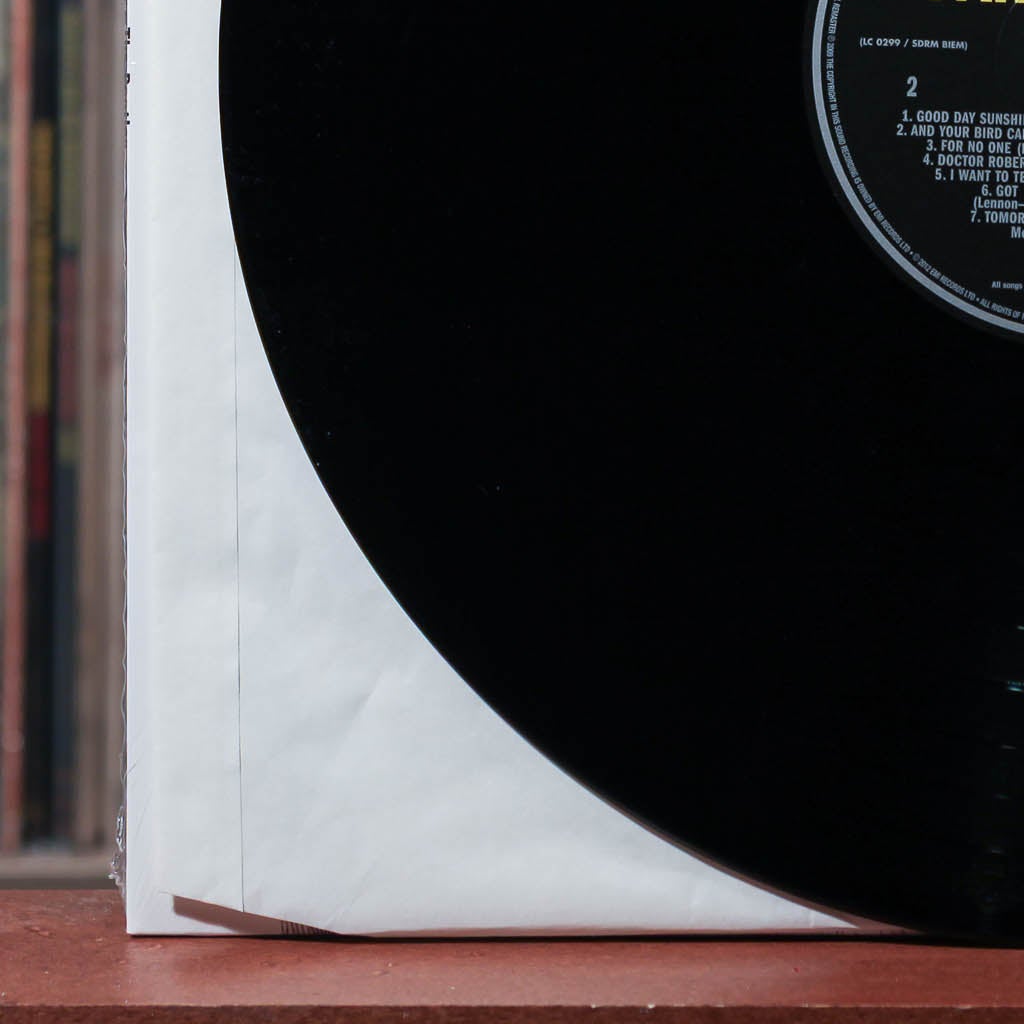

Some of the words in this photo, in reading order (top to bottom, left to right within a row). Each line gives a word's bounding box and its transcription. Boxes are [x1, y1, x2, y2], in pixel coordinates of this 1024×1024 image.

[859, 37, 873, 48] (LC
[876, 38, 901, 47] 0299
[912, 39, 939, 49] SDRM
[942, 40, 968, 51] BIEM)
[906, 75, 918, 97] 2
[902, 109, 913, 122] 1.
[916, 110, 950, 123] GOOD
[953, 111, 976, 124] DAY
[896, 124, 908, 136] 2.
[910, 124, 935, 137] AND
[940, 125, 970, 138] YOUR
[974, 126, 1003, 139] BIRD
[926, 139, 937, 152] 3.
[941, 139, 963, 153] FOR
[967, 140, 984, 153] NO
[988, 141, 1012, 154] ONE
[922, 153, 934, 166] 4.
[937, 154, 984, 167] DOCTOR
[935, 168, 946, 181] 5.
[950, 169, 954, 181] I
[958, 169, 991, 182] WANT
[994, 170, 1009, 183] TO
[981, 183, 992, 197] 6.
[996, 184, 1019, 197] GOT
[970, 210, 981, 223] 7.
[991, 281, 1001, 289] All
[1002, 282, 1023, 290] songs
